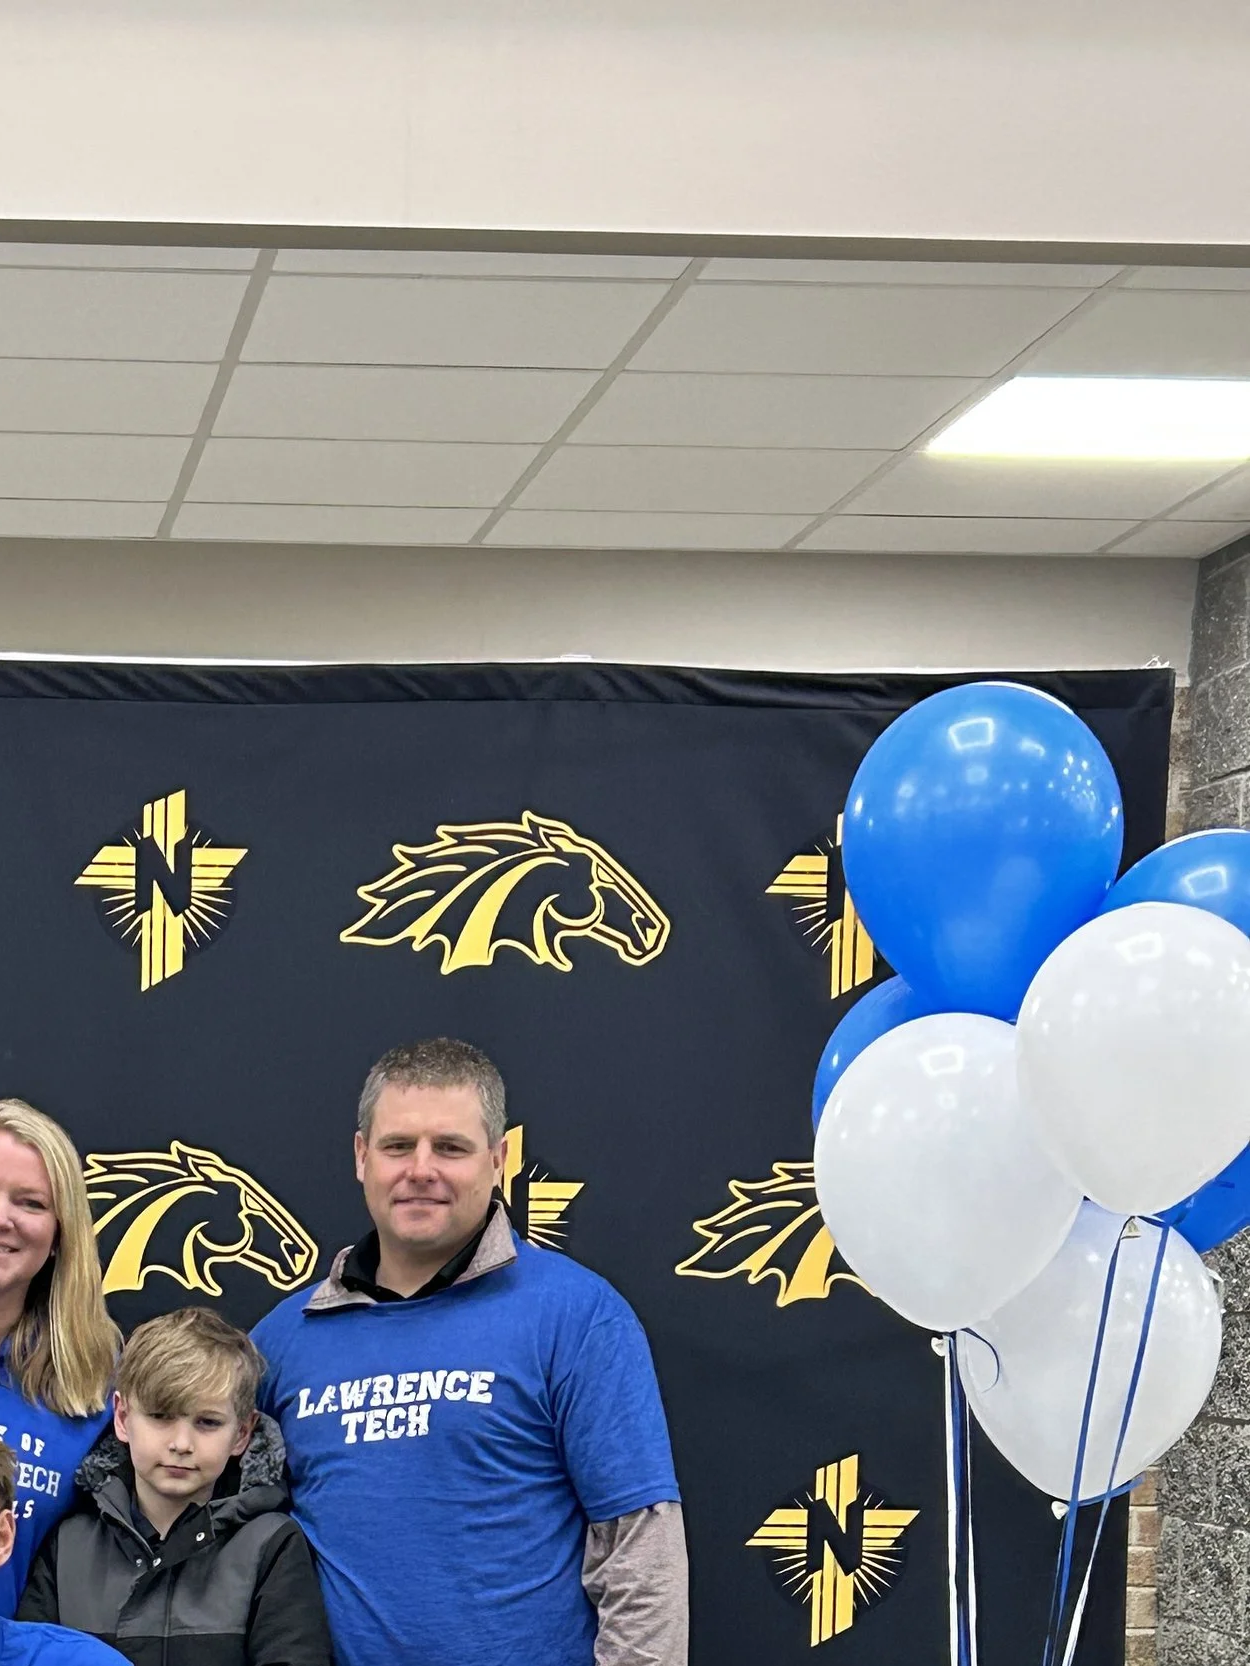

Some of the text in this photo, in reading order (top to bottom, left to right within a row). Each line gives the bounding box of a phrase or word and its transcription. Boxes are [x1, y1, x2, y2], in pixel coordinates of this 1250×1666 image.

[296, 1369, 496, 1419] LAWRENCE
[340, 1403, 432, 1444] TECH
[20, 1433, 45, 1457] OF
[12, 1461, 61, 1496] ECH
